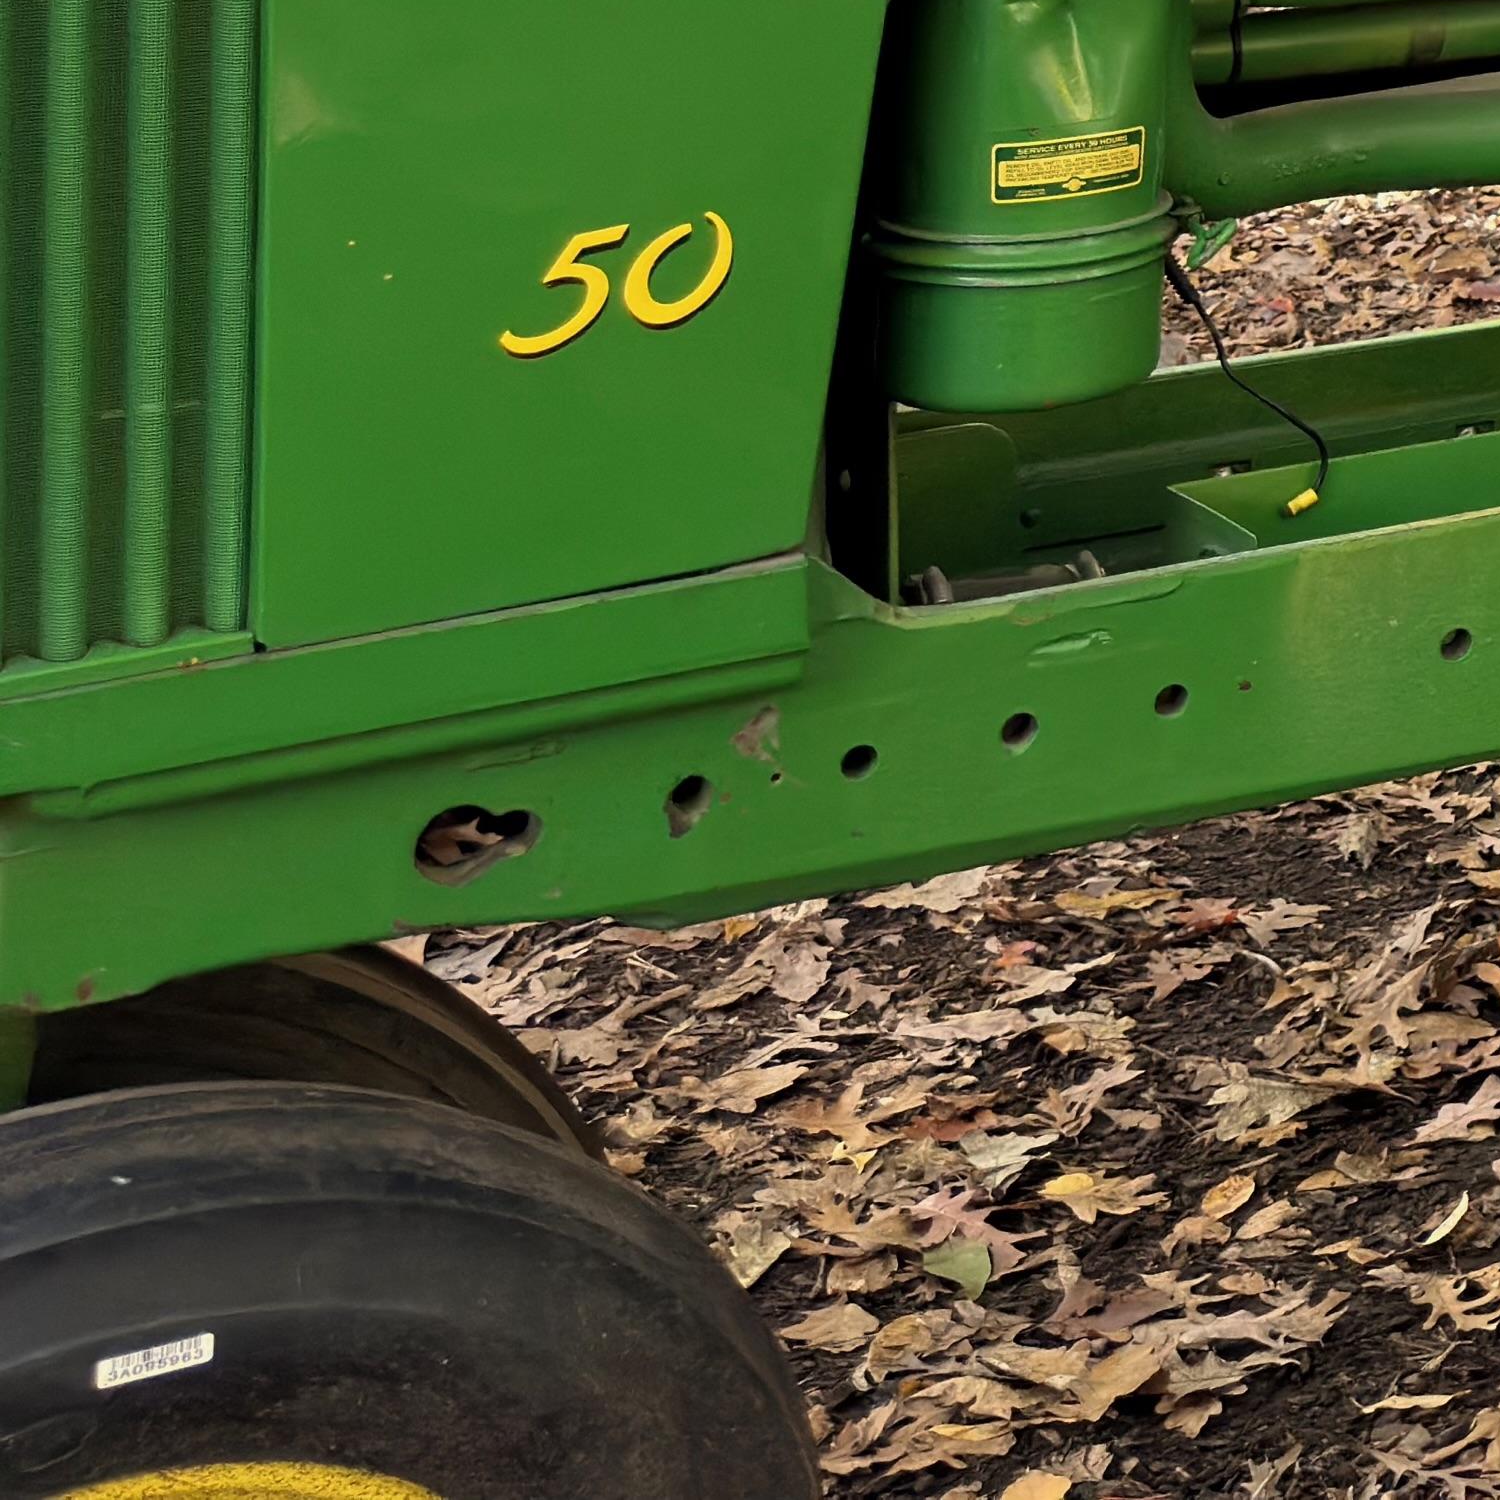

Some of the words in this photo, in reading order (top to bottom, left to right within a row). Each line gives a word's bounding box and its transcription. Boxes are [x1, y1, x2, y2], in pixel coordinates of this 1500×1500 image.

[1017, 145, 1057, 155] SERVICE
[1058, 141, 1087, 151] EVERY
[1100, 135, 1128, 145] HOURS
[499, 210, 733, 360] 50
